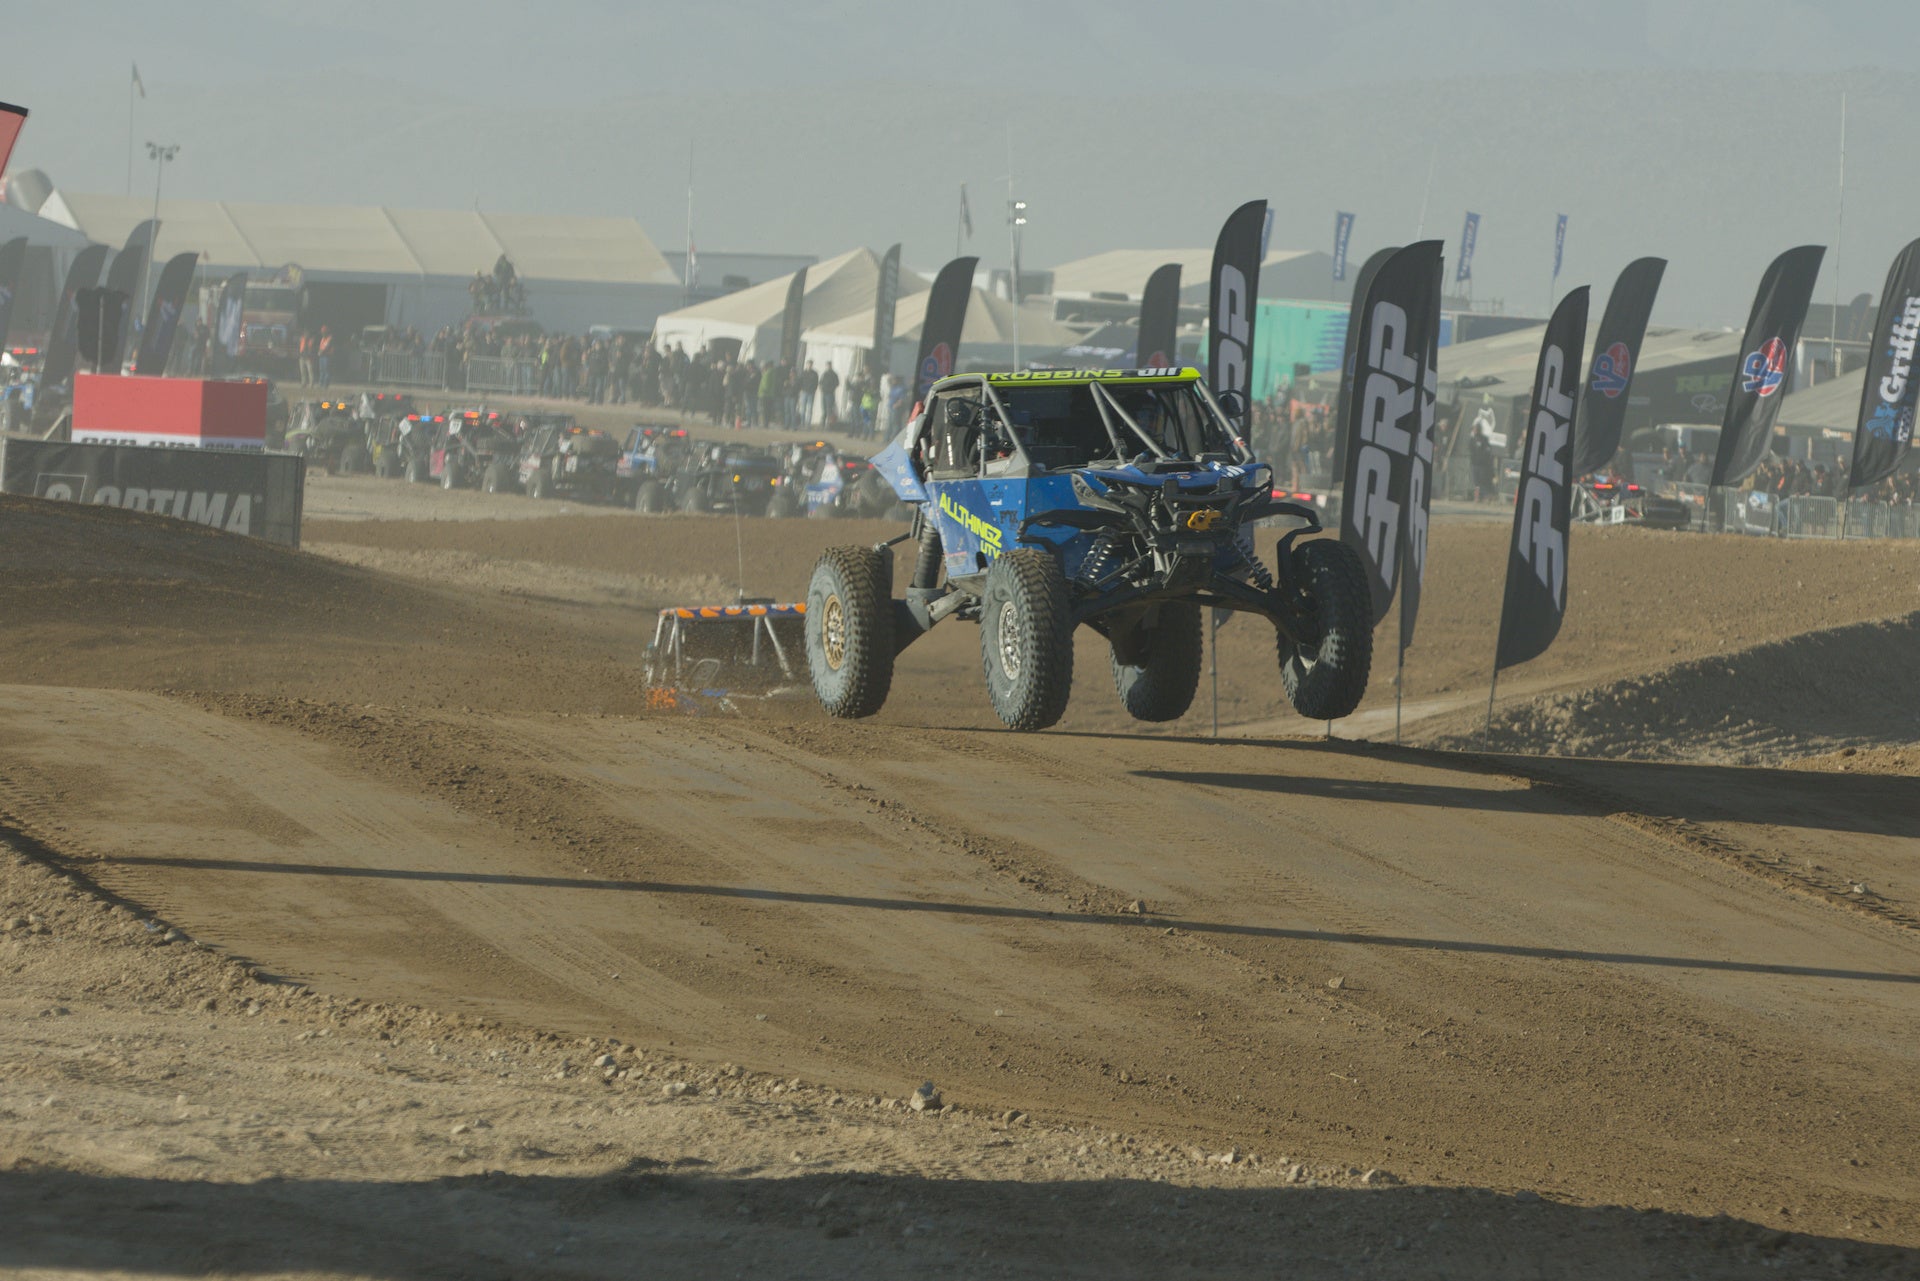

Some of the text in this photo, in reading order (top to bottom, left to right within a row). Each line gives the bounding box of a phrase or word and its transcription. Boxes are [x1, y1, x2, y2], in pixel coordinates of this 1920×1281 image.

[1591, 353, 1628, 391] VP
[1743, 351, 1784, 393] VP
[1880, 296, 1920, 403] Griffin
[990, 369, 1124, 381] ROBBINS
[1352, 300, 1418, 592] PRP
[1518, 343, 1575, 612] PRP
[939, 492, 1002, 549] ALLTHINGZ
[980, 540, 1001, 560] UTV
